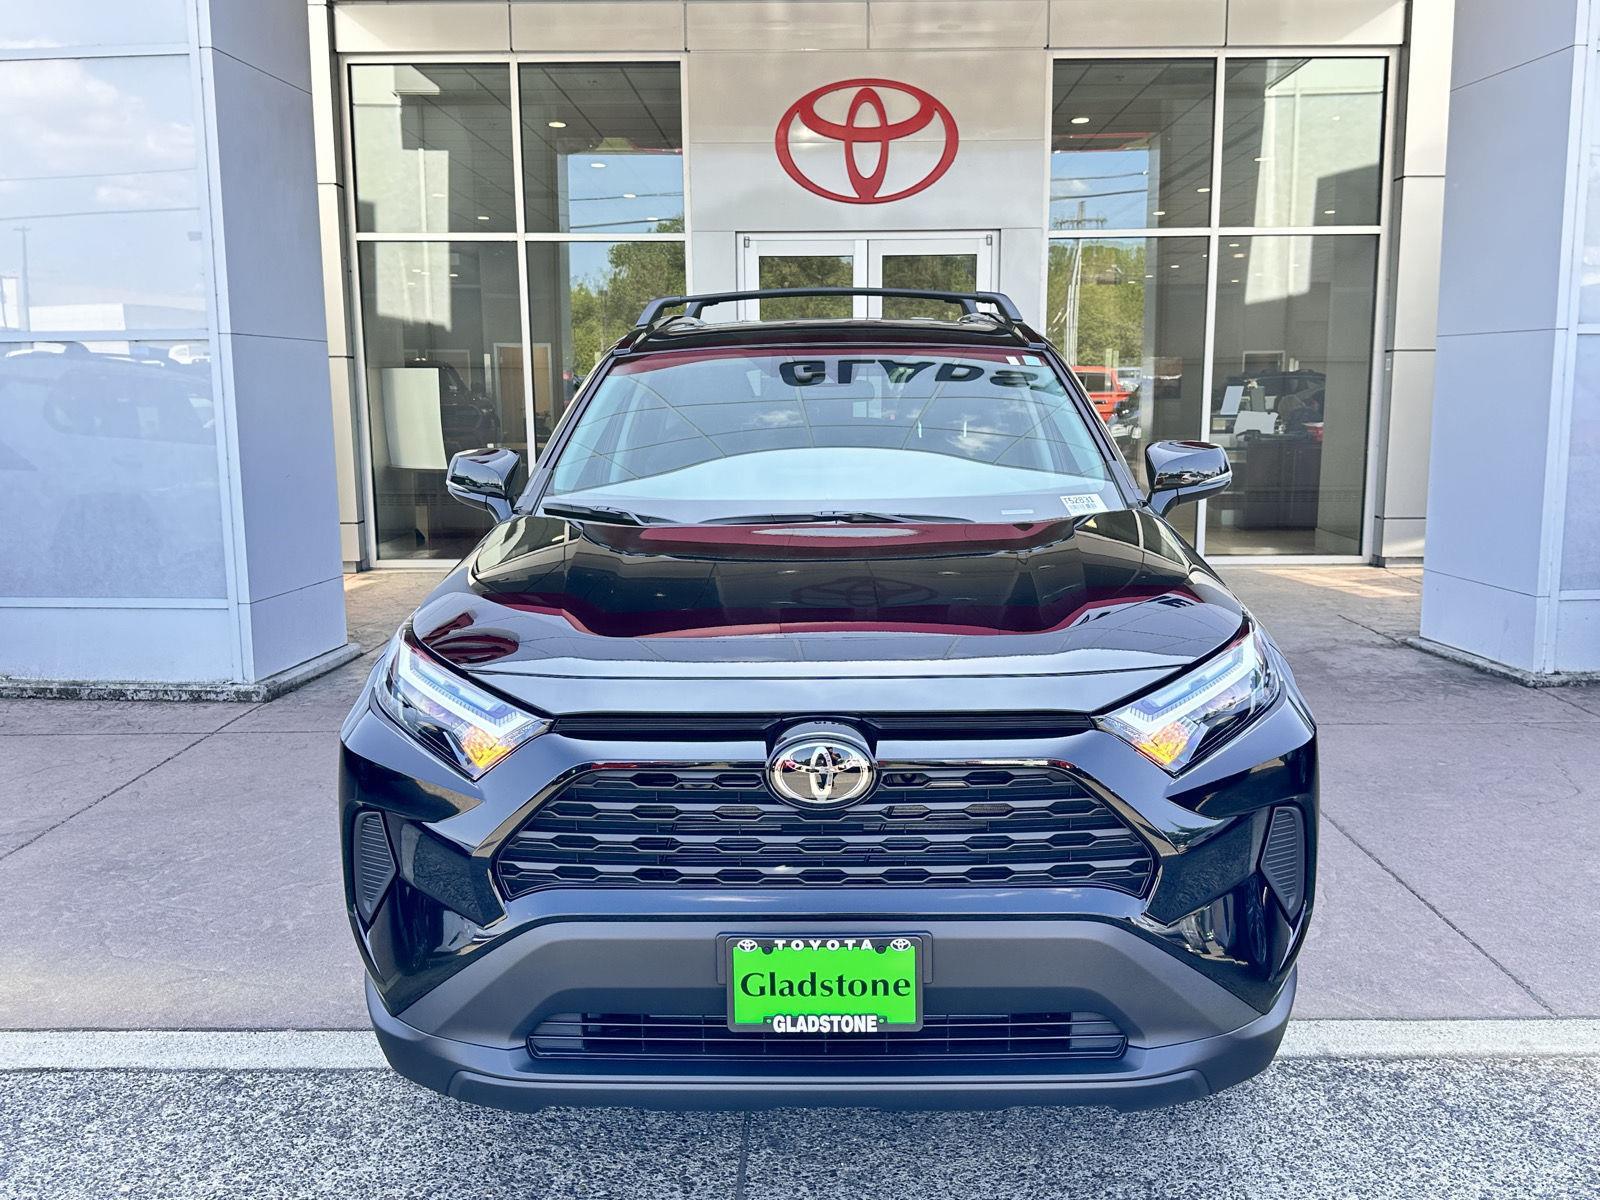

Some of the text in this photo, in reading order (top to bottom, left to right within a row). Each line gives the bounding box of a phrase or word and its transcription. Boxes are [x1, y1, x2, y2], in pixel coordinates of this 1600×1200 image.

[774, 939, 876, 951] TOYOTA
[740, 972, 911, 998] Gladstone
[772, 1015, 878, 1033] GLADSTONE
